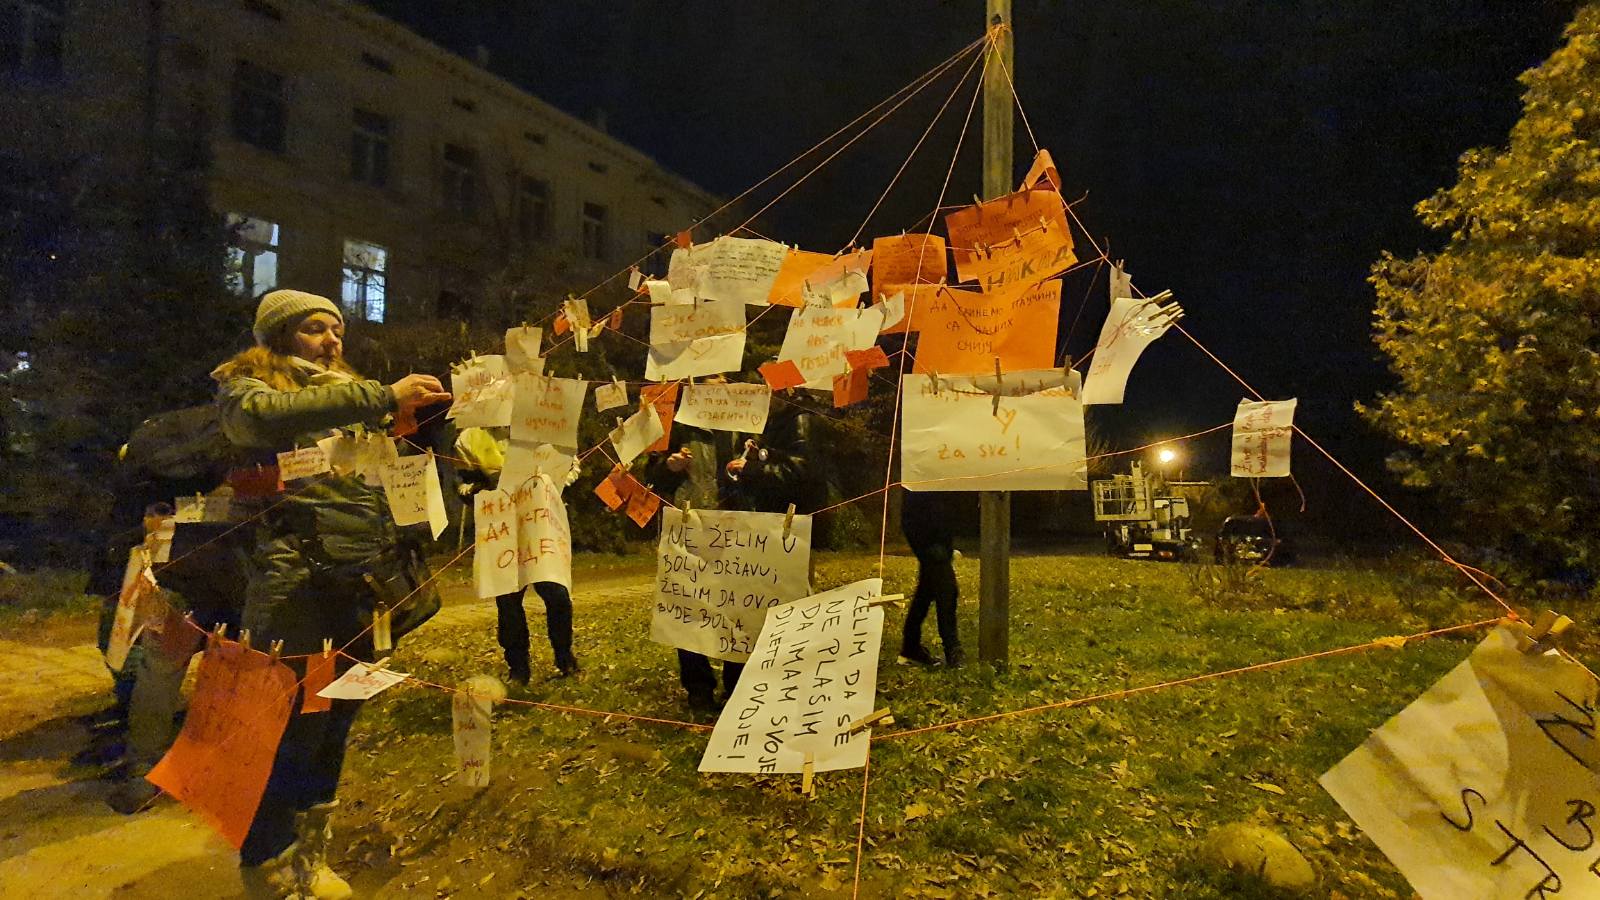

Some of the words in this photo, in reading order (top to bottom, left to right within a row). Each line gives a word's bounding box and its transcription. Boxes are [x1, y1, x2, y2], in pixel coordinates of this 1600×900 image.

[667, 524, 698, 550] NE
[708, 523, 768, 552] ŽELIM
[782, 536, 797, 554] U
[660, 577, 711, 603] ŽELIM
[717, 588, 735, 608] DA
[743, 594, 780, 609] OVO
[657, 602, 693, 624] BUDE
[796, 603, 821, 632] DA
[821, 599, 846, 632] NE
[848, 591, 872, 658] ŽELIM
[760, 605, 795, 671] DIJETE
[777, 639, 810, 702] IMAM
[793, 638, 841, 737] PLAŠIM
[843, 669, 861, 700] DA
[758, 715, 789, 774] SVOJE
[834, 713, 852, 748] SE
